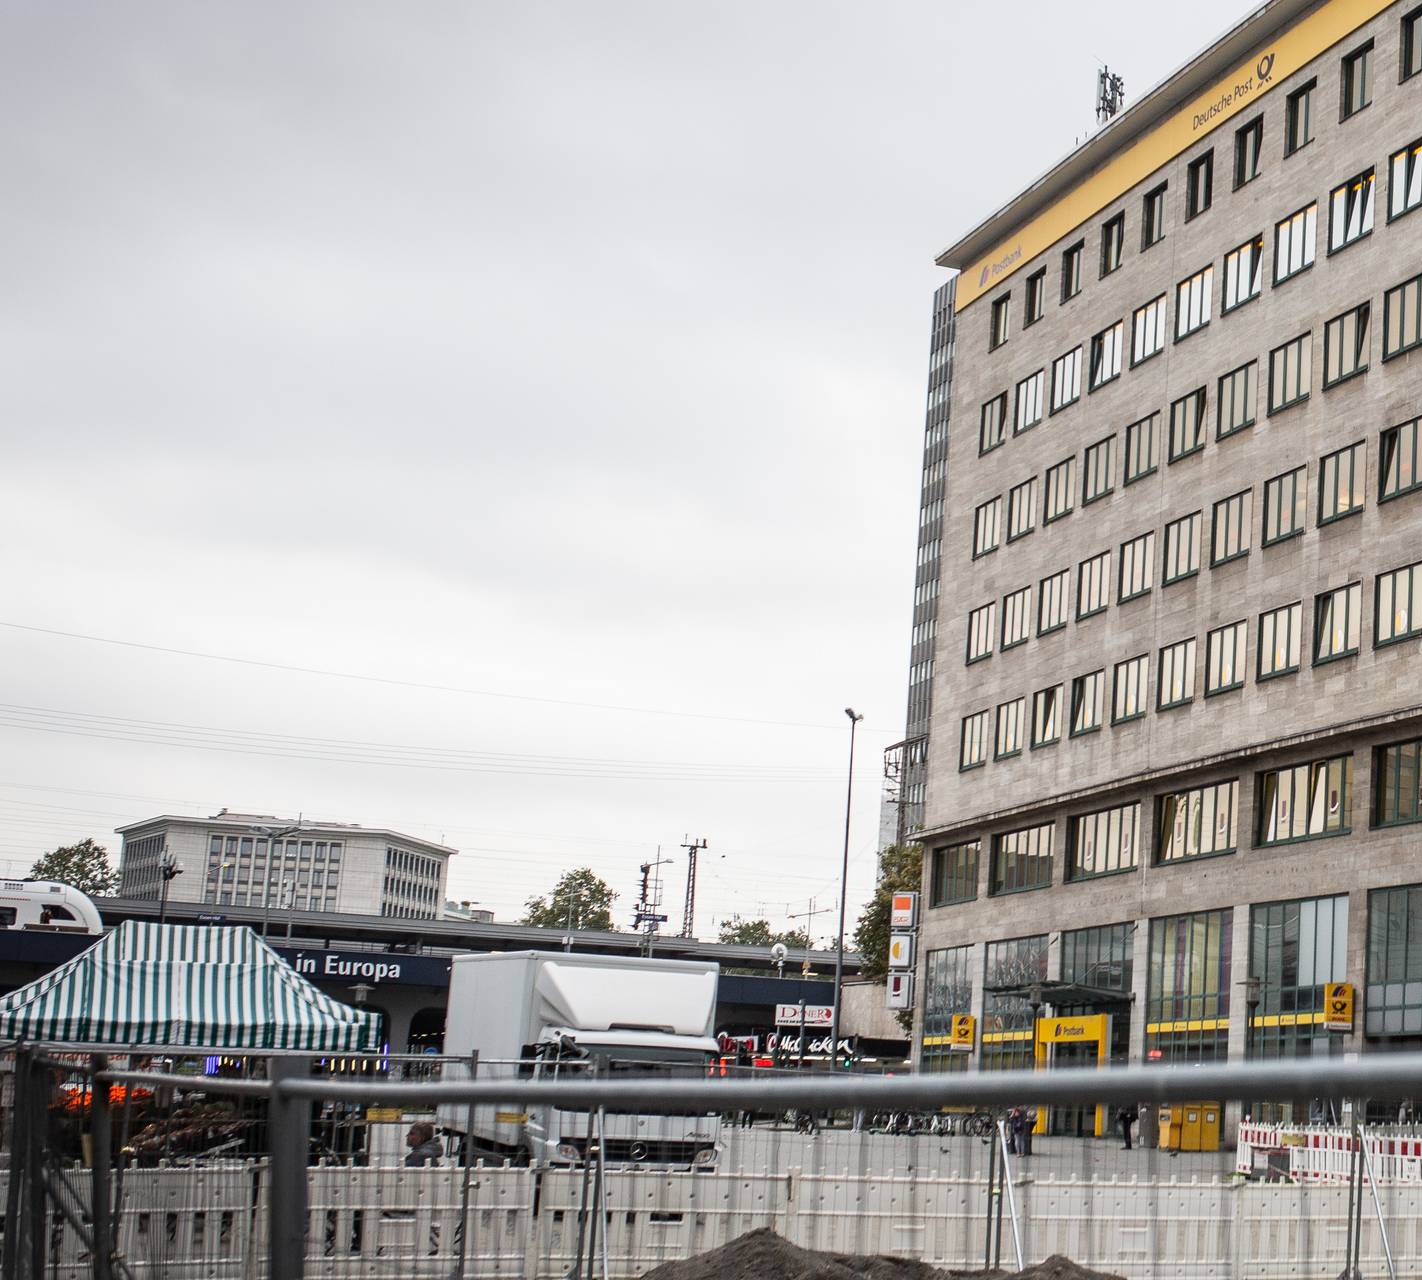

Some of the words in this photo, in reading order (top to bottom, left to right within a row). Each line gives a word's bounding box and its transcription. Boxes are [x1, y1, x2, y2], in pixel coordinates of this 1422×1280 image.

[1193, 94, 1232, 130] Deutsche
[1234, 77, 1253, 101] Post
[992, 245, 1022, 278] Postbank
[296, 954, 315, 973] in
[325, 955, 400, 983] Europa
[781, 1007, 825, 1018] DNER
[1063, 1025, 1085, 1035] Postbank
